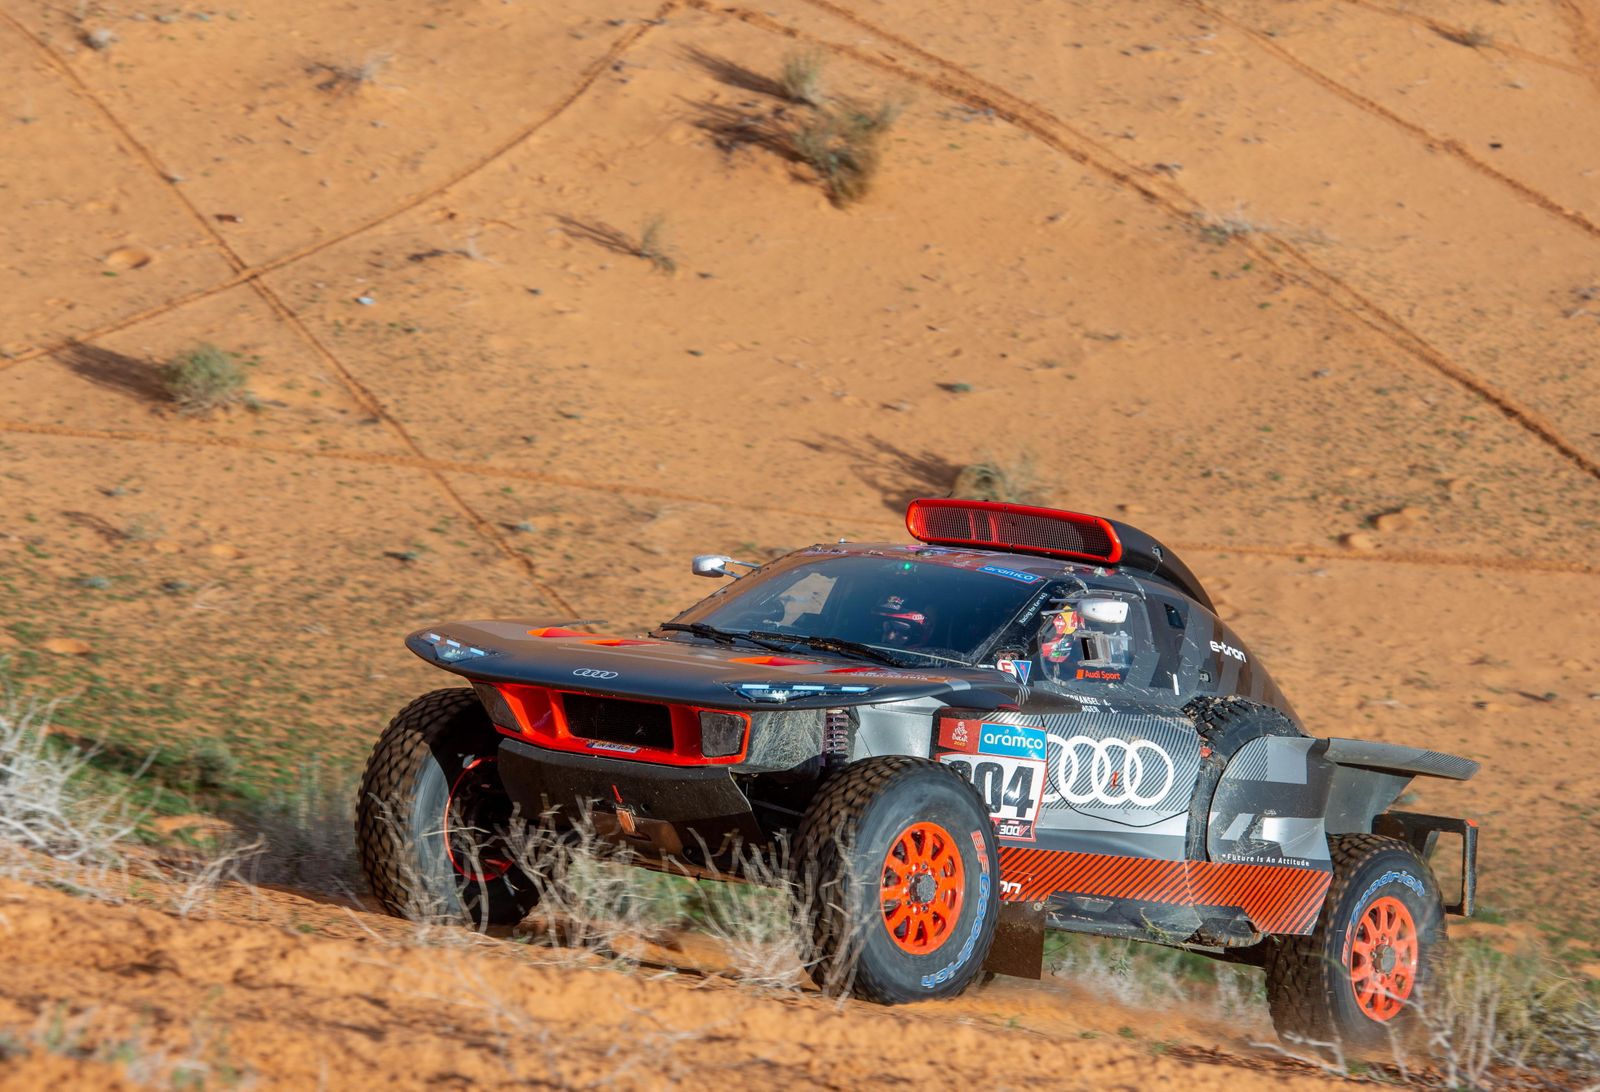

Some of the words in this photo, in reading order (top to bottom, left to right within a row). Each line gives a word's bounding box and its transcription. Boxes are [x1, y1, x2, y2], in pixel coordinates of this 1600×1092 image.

[984, 566, 1034, 580] aramco
[1209, 640, 1247, 663] e-tron
[1085, 670, 1101, 679] Audi
[1101, 671, 1121, 681] Sport
[984, 730, 1044, 750] aramco
[1227, 853, 1255, 863] Future
[1266, 856, 1276, 864] An
[1278, 857, 1310, 867] Attitude
